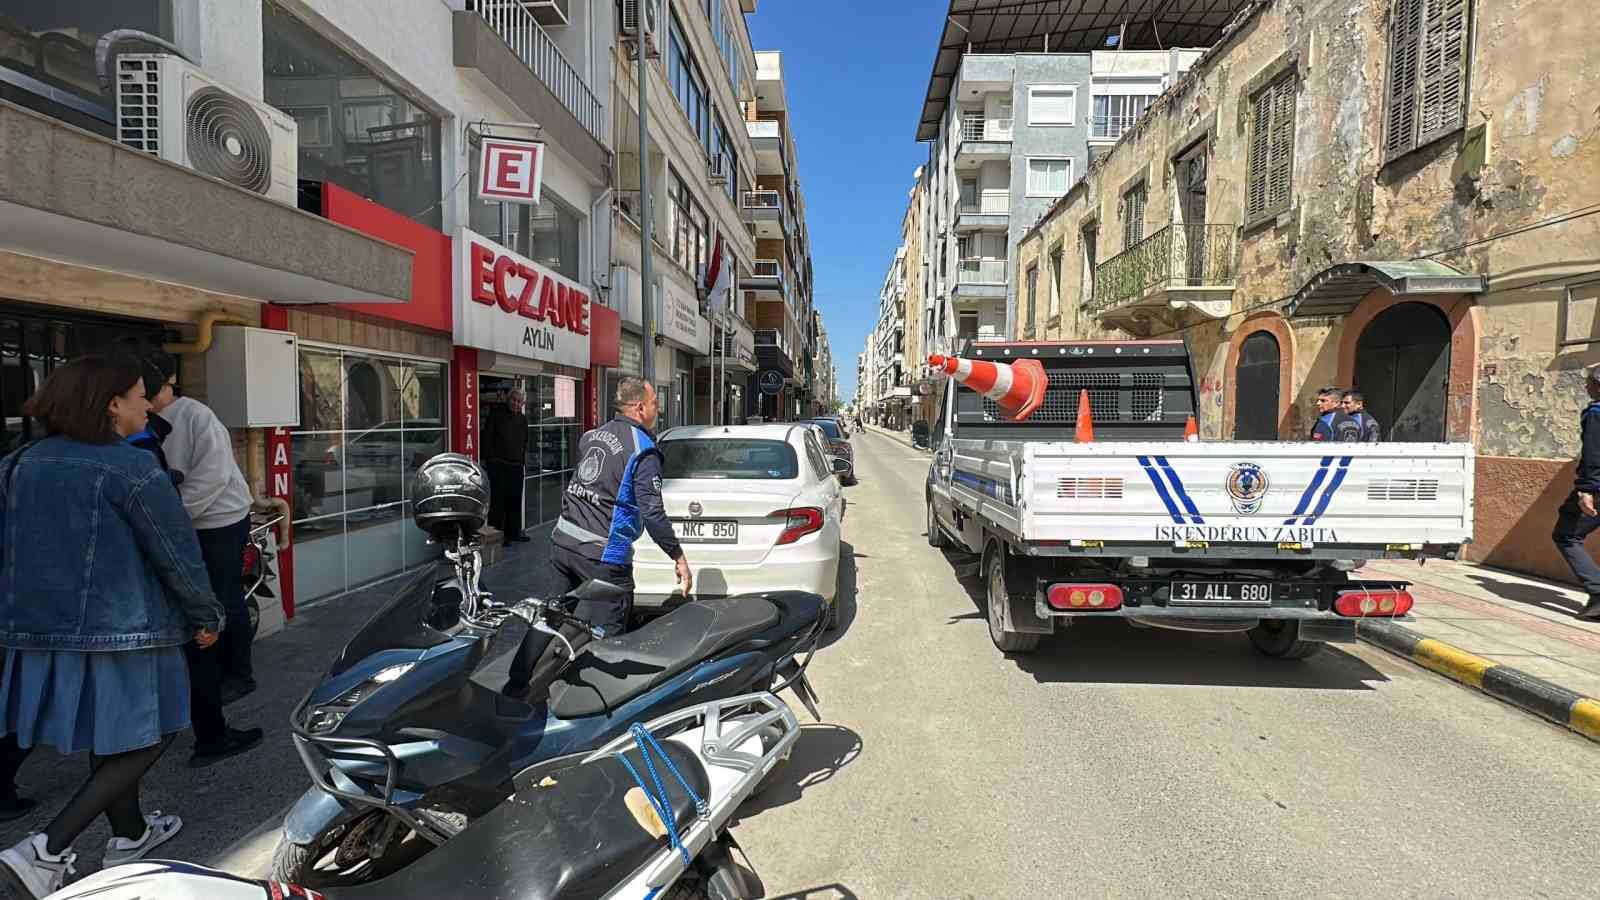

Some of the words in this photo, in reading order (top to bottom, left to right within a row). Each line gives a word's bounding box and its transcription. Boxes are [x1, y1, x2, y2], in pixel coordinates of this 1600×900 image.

[496, 152, 523, 189] E
[470, 240, 590, 336] ECZANE
[522, 325, 555, 351] AYLİN
[682, 521, 705, 537] NKC
[712, 522, 735, 537] 850
[1155, 523, 1268, 541] İSKENDERUN
[1273, 525, 1338, 542] ZABITA
[1181, 583, 1197, 600] 31
[1204, 584, 1232, 600] ALL
[1241, 584, 1268, 600] 680
